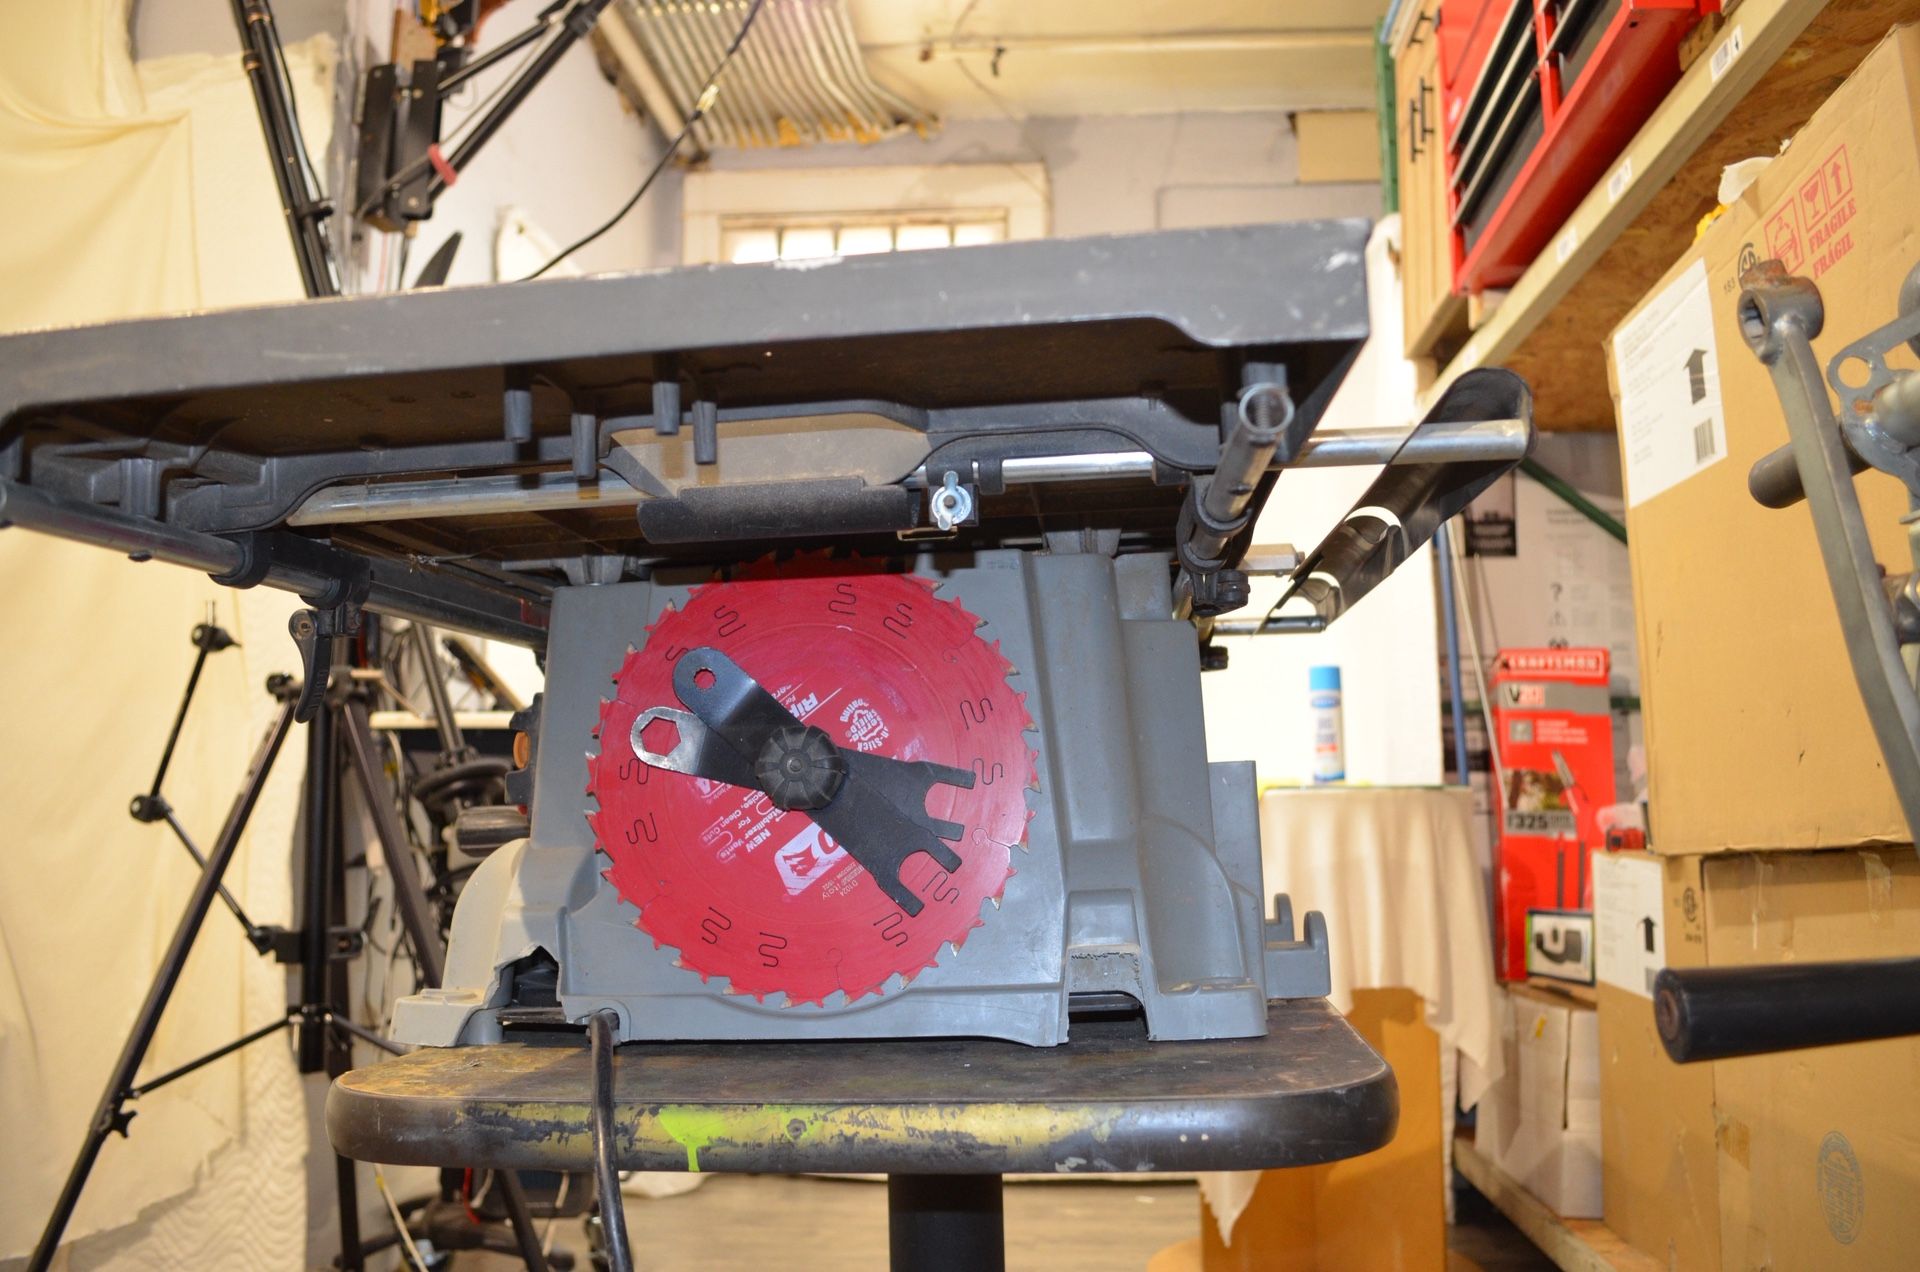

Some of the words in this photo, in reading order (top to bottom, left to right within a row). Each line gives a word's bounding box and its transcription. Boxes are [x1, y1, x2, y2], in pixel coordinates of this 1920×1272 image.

[1808, 197, 1856, 255] FRAGILE
[1812, 231, 1855, 279] FRÁGIL
[719, 808, 742, 828] Clean
[735, 816, 751, 830] For
[743, 827, 771, 852] NEW
